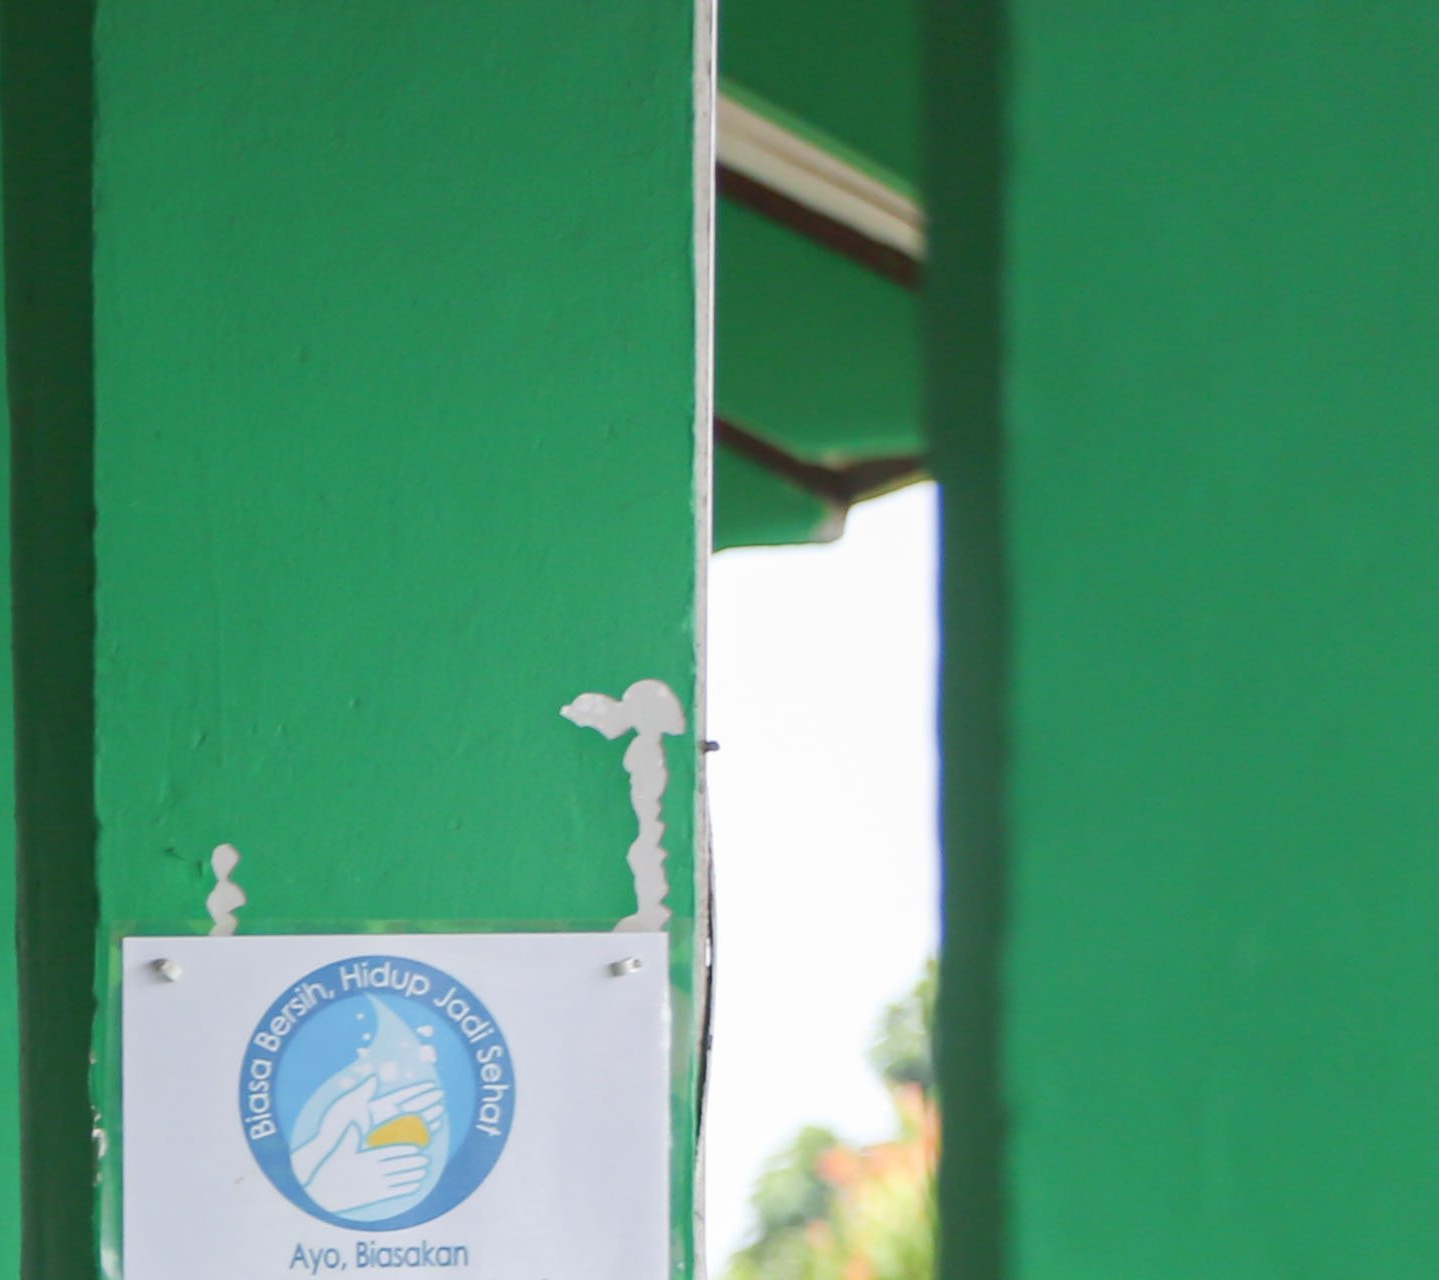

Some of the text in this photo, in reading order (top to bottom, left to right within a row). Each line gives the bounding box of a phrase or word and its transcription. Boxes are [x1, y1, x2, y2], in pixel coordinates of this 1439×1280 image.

[249, 960, 509, 1141] Biasa Bersih, Hidup Jadi Sehat
[289, 1240, 470, 1272] Ayo, Biasakan
